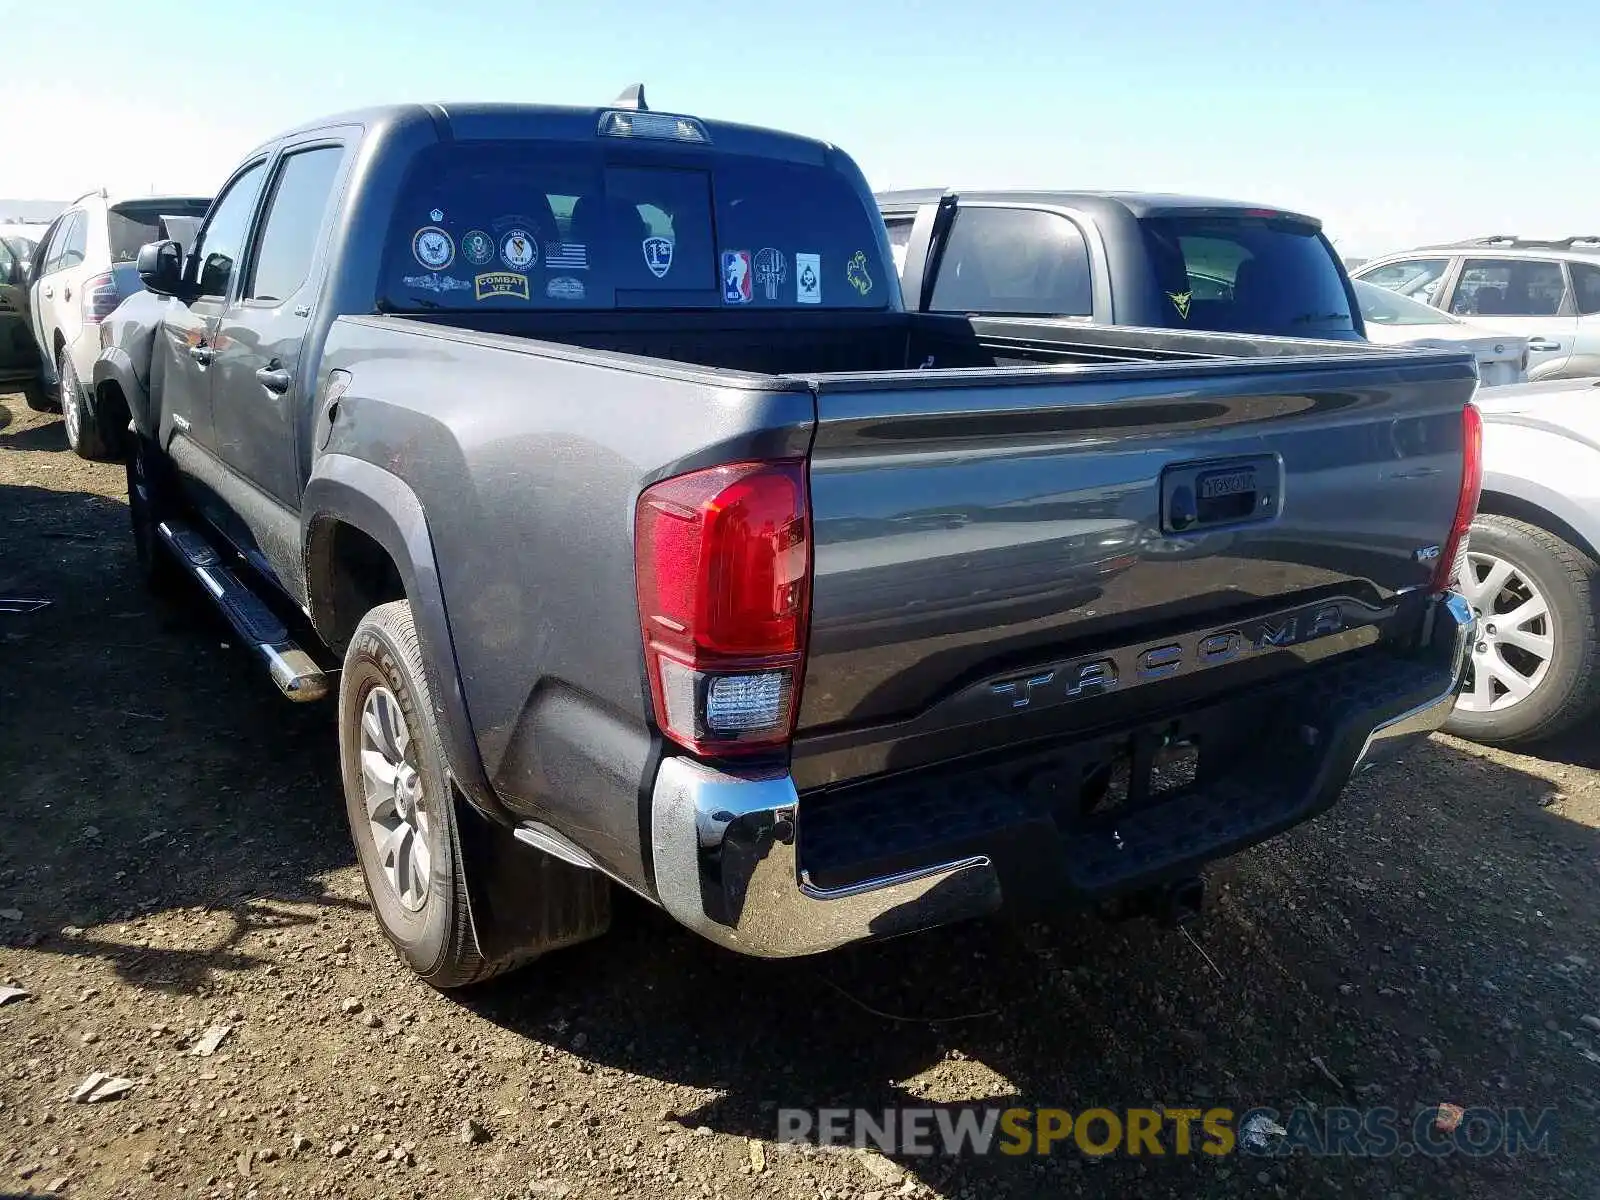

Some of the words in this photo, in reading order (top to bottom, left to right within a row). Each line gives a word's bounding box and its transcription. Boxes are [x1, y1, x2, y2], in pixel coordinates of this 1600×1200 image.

[478, 276, 523, 286] COMBAT
[1416, 545, 1440, 562] V6
[991, 604, 1344, 708] TACOMA
